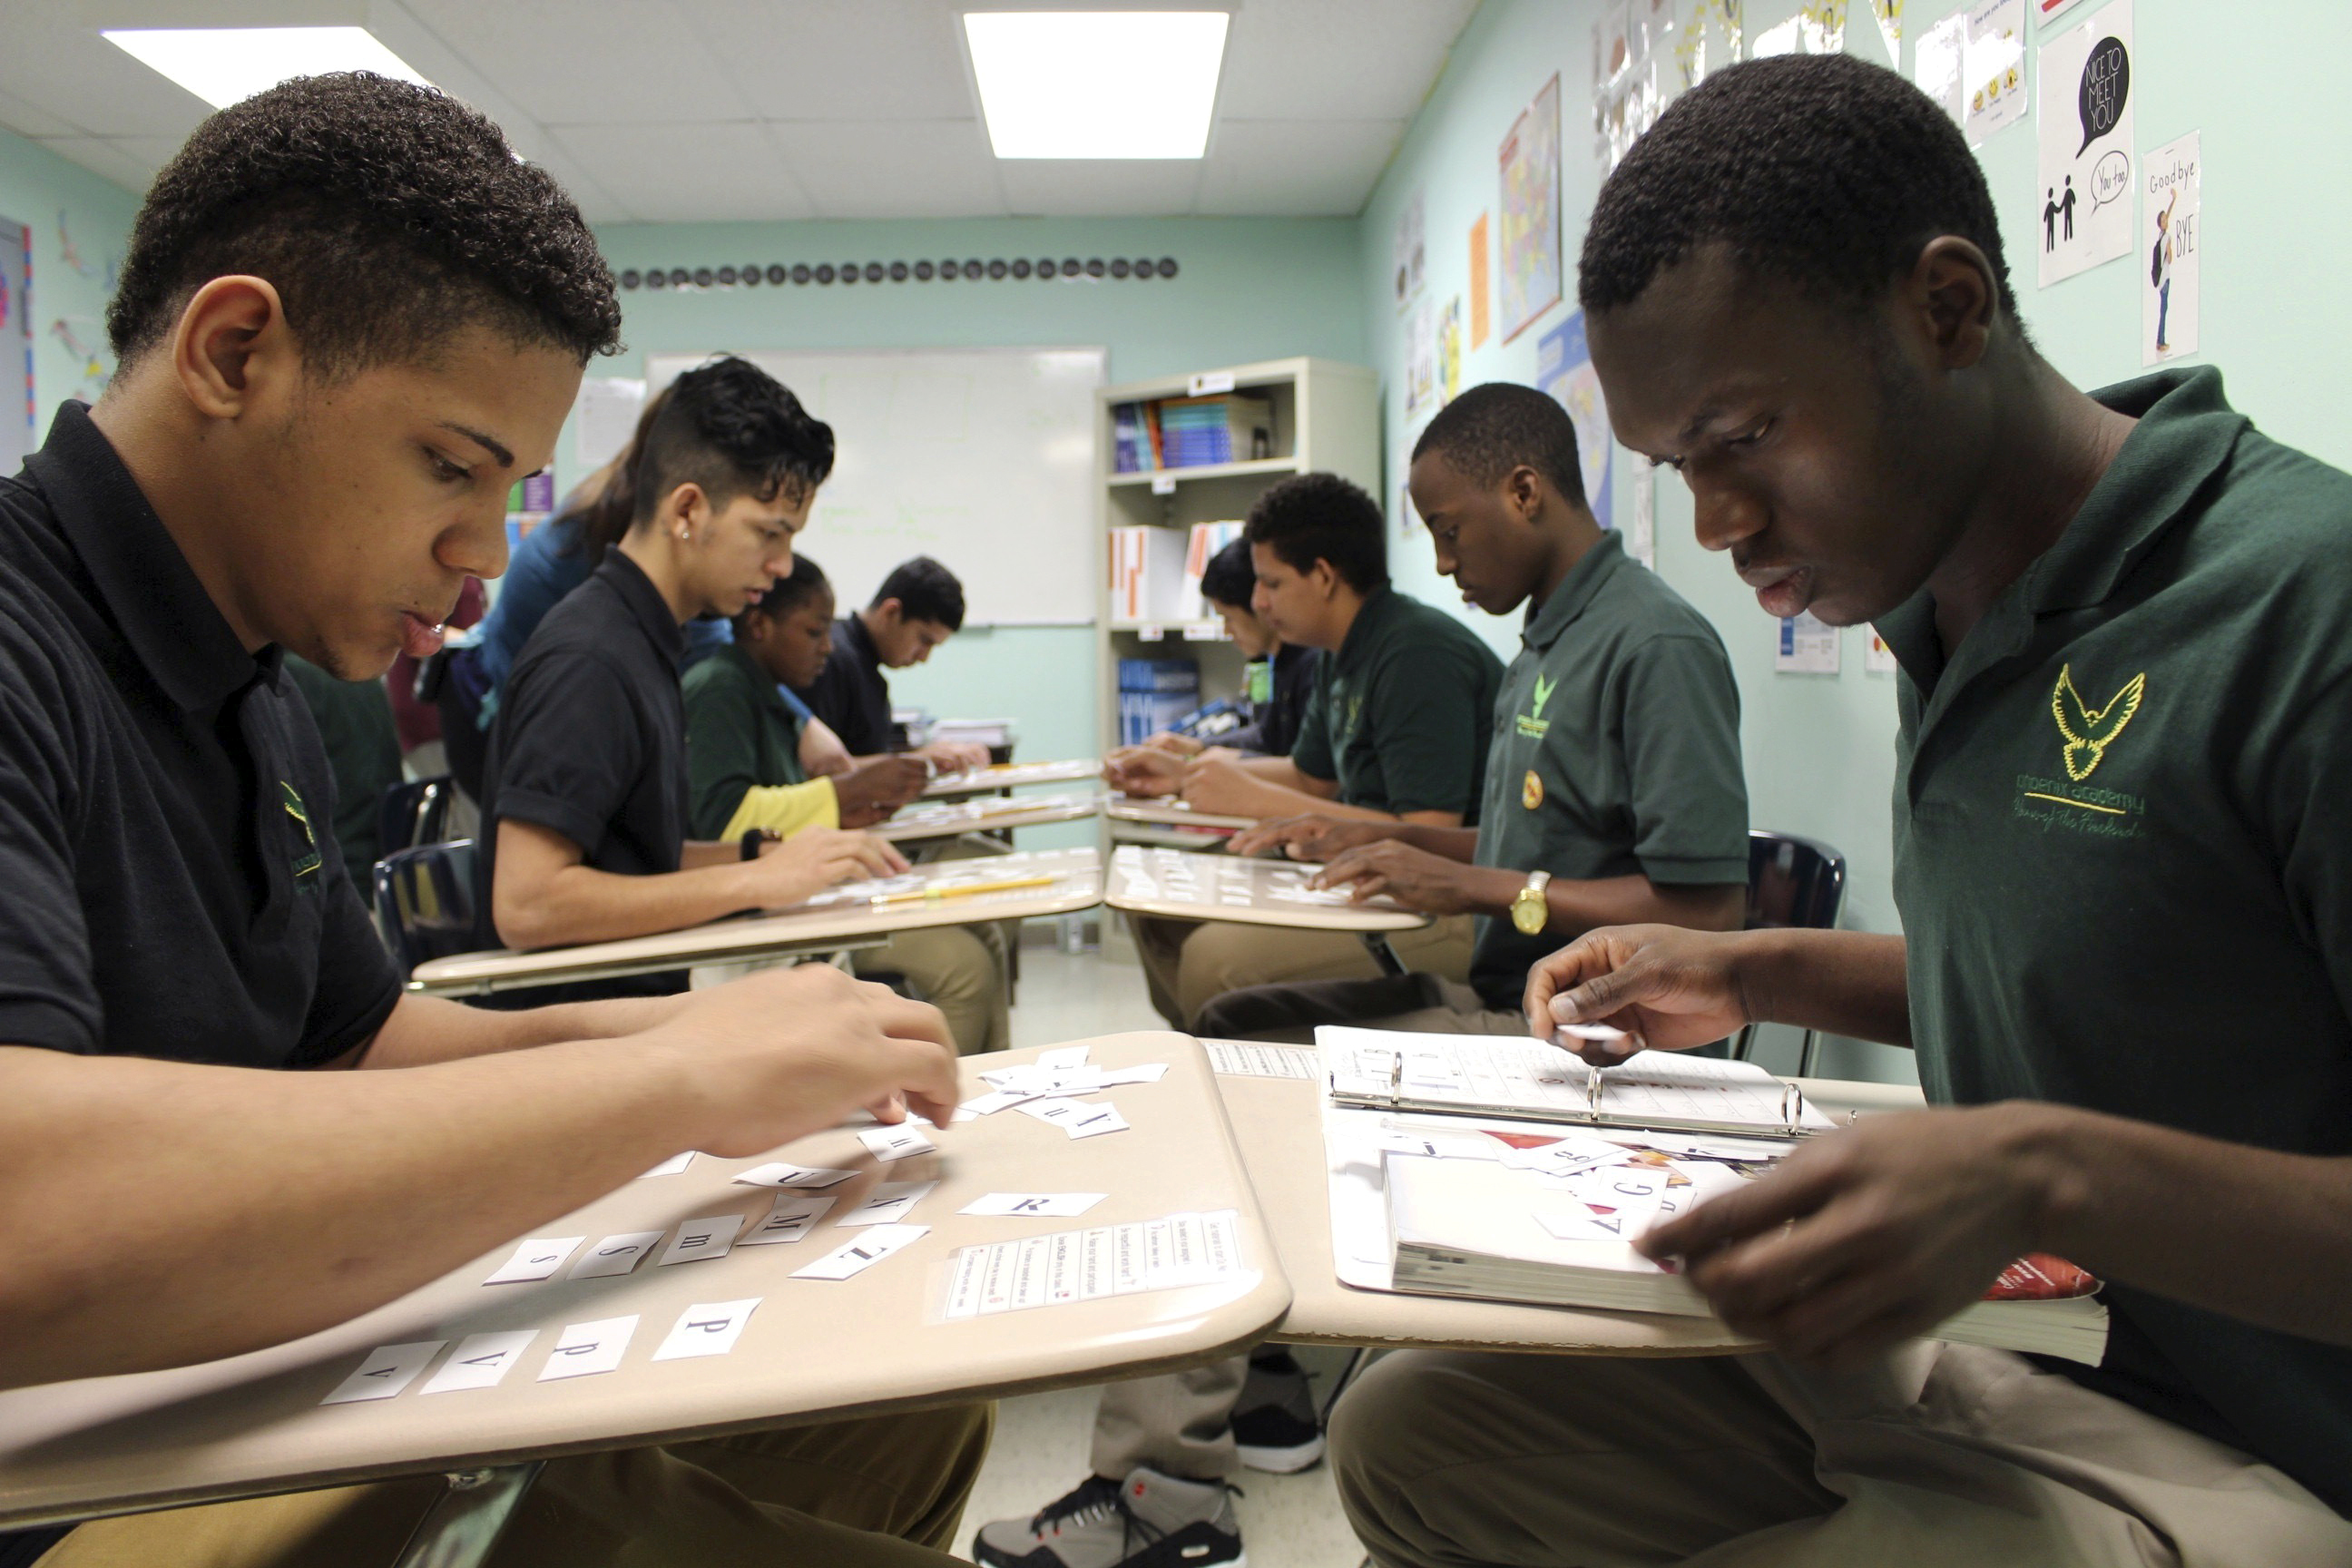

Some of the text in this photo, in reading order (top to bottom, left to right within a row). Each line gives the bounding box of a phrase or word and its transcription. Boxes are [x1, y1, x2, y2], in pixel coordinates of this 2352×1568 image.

[2086, 47, 2122, 88] NICE TO
[2089, 72, 2119, 110] MEET
[2091, 98, 2114, 132] YOU
[2098, 165, 2112, 198] You
[2150, 160, 2195, 194] Goodbye
[2177, 214, 2194, 259] BYE
[2072, 785, 2146, 816] academy
[1009, 1198, 1051, 1211] R
[1613, 1181, 1653, 1197] G
[761, 1212, 813, 1232] M
[678, 1233, 712, 1250] m
[685, 1318, 732, 1334] P
[552, 1341, 601, 1356] p
